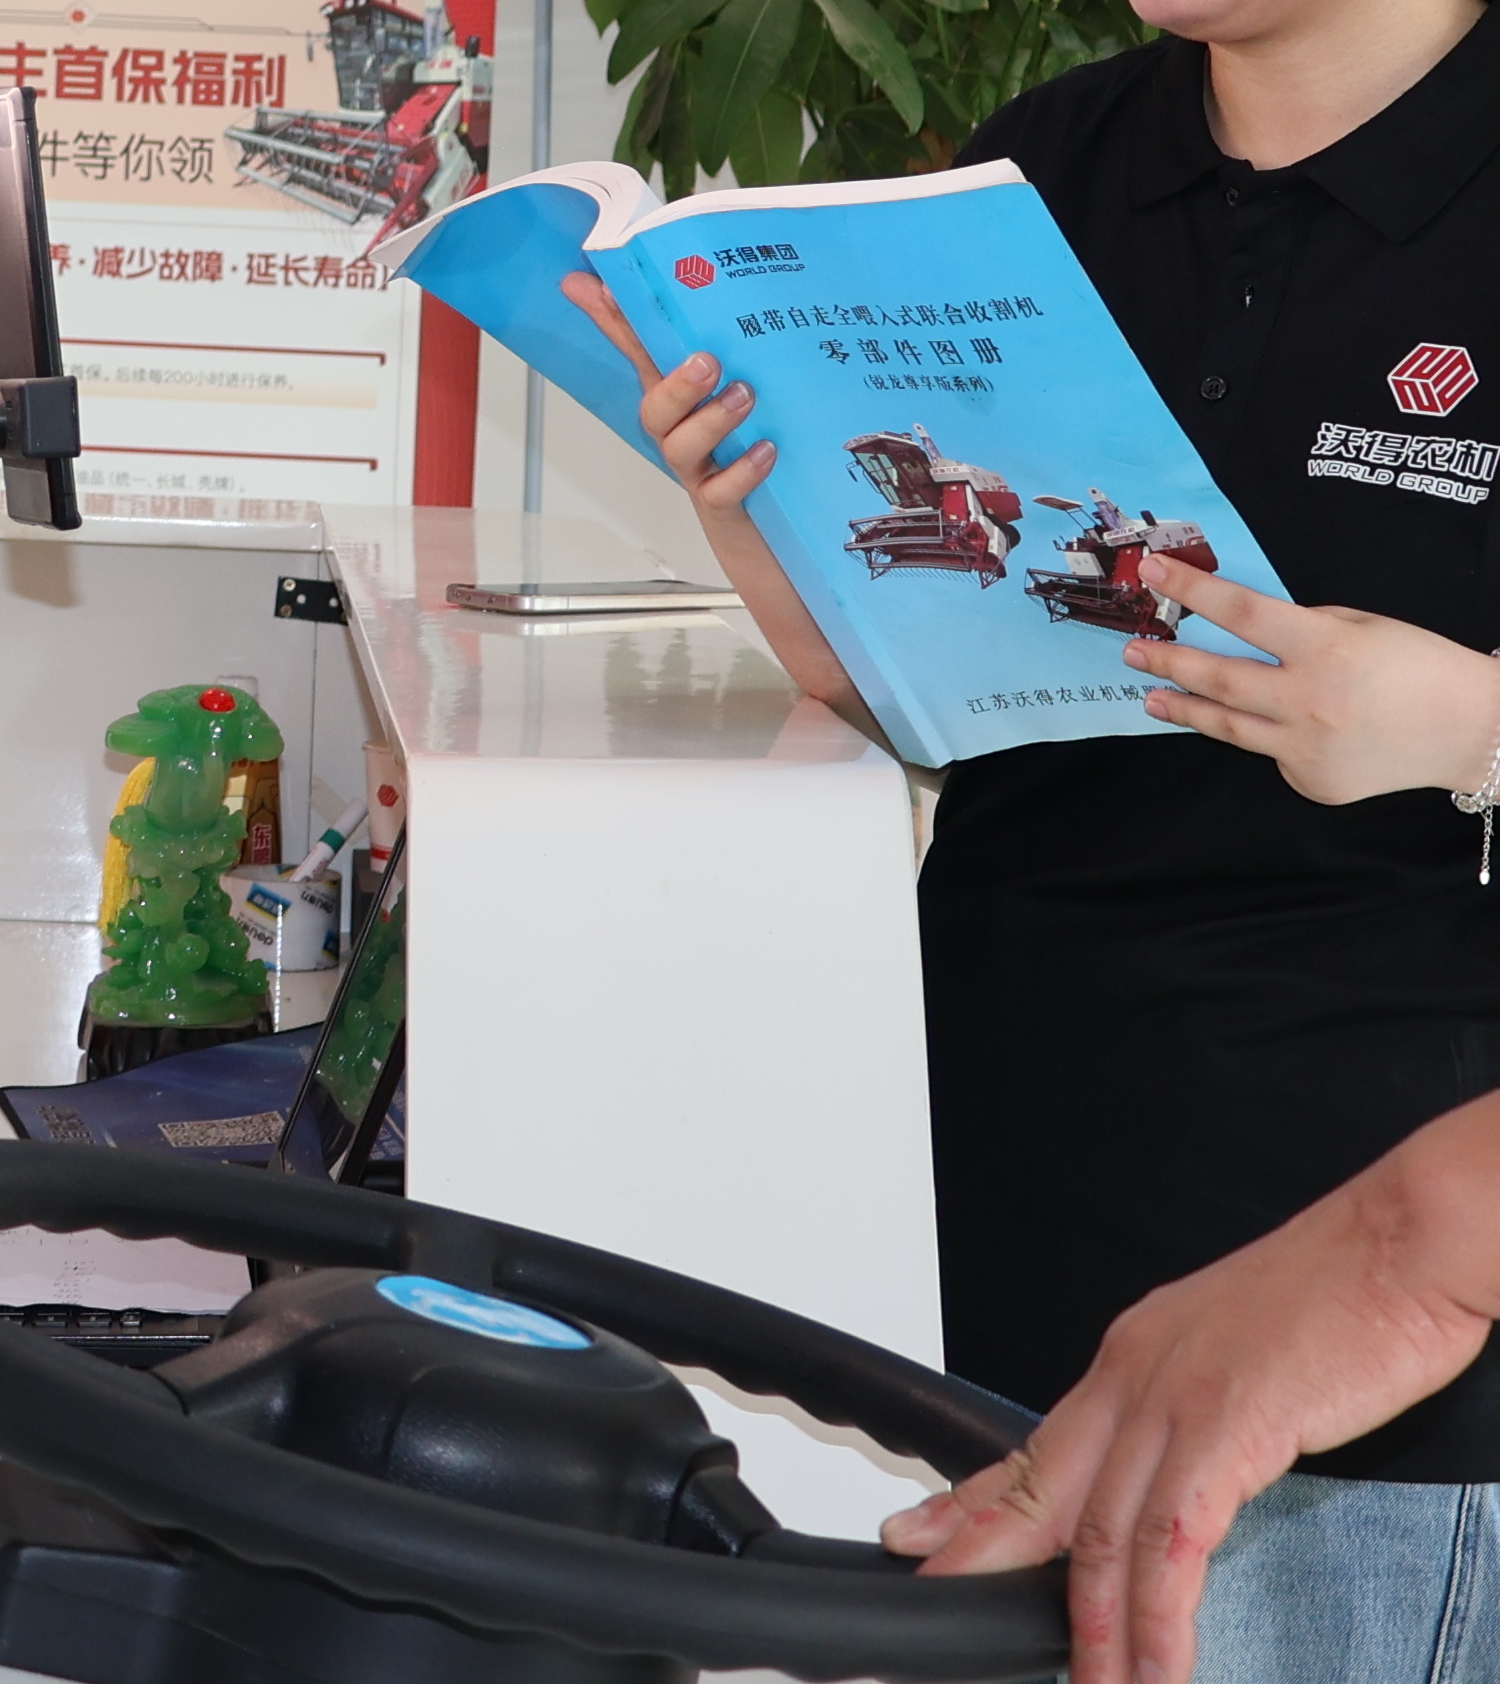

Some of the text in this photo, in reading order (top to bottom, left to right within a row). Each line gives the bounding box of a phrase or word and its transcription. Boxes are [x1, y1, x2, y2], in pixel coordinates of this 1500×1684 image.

[713, 243, 800, 269] 沃得集团
[725, 263, 806, 280] WORLD GROUP
[736, 295, 1044, 339] 履带自走全喂入式联合收割机
[818, 337, 1004, 366] 零部件图册
[1307, 459, 1490, 504] WORLD GROUP
[966, 683, 1182, 716] 江苏沃得农业机械
